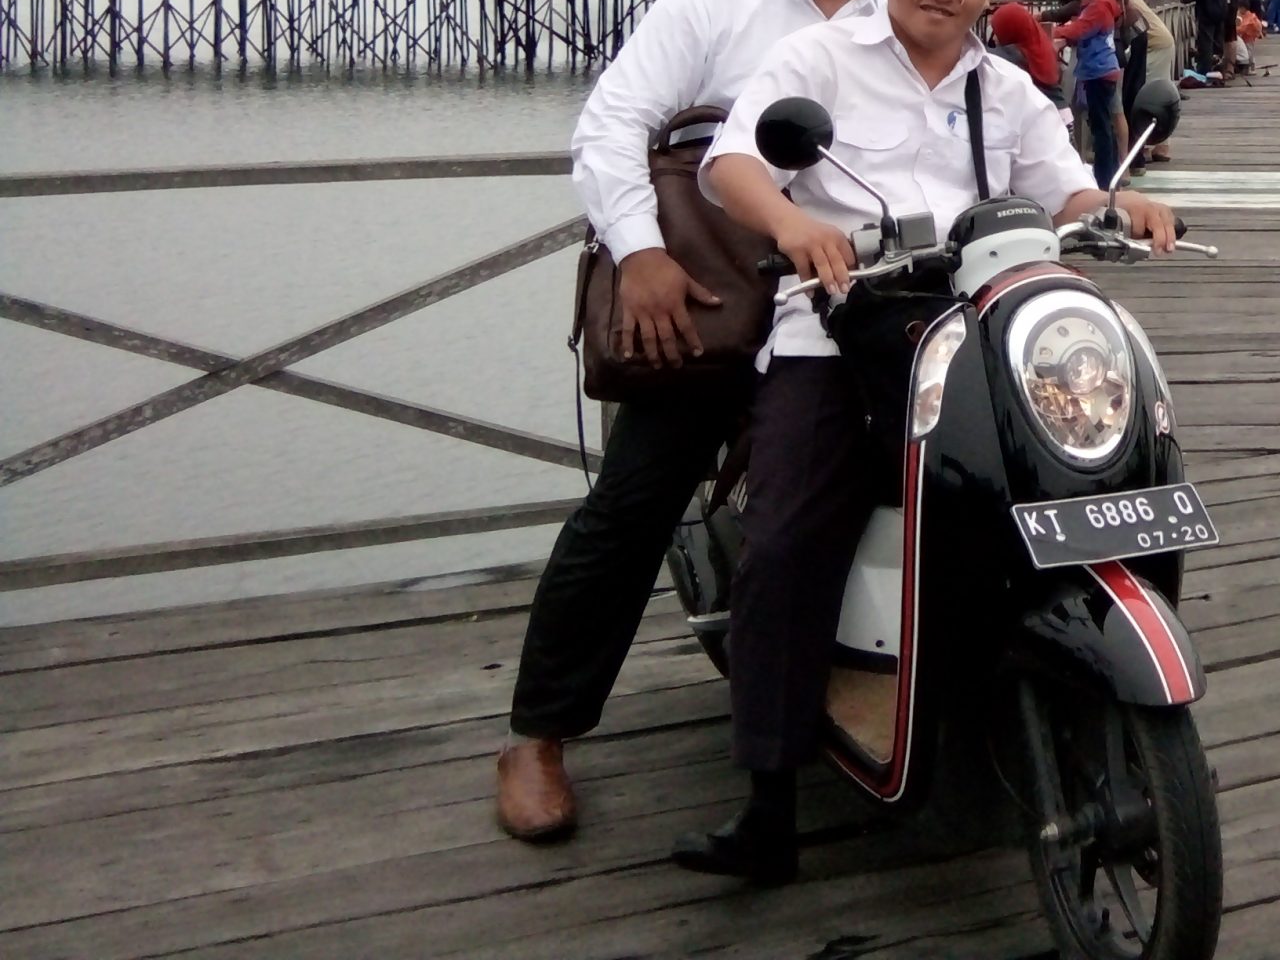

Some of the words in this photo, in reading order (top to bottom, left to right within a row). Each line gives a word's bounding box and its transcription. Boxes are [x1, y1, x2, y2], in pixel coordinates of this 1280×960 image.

[996, 207, 1038, 218] HONDA
[1024, 509, 1061, 536] KT
[1085, 497, 1155, 529] 6886
